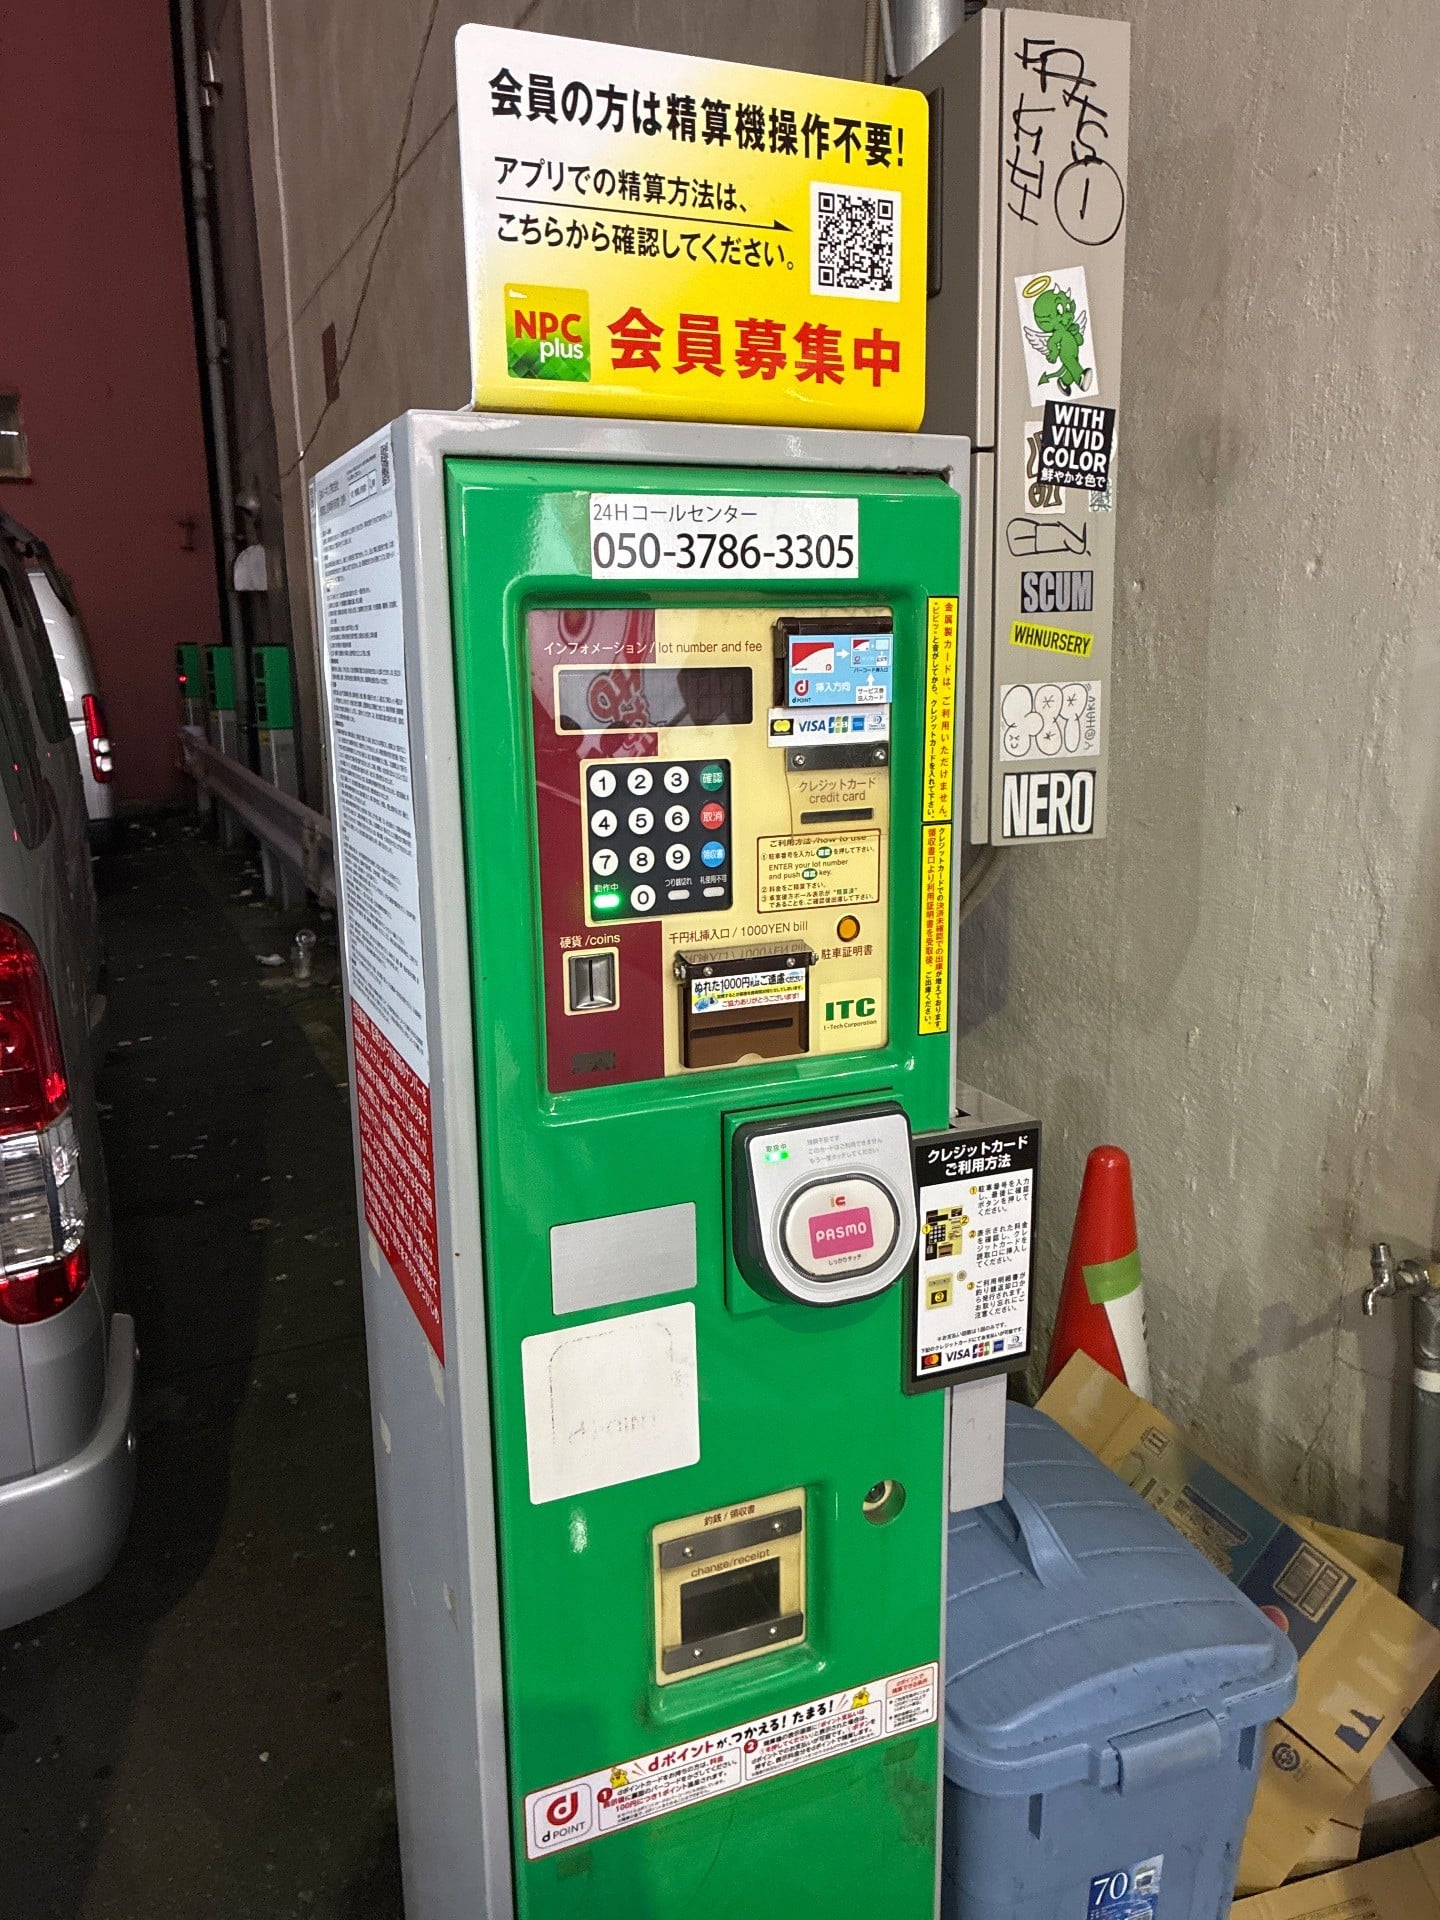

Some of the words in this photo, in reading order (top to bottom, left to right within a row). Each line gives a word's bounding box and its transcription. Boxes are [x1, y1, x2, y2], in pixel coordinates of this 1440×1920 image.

[489, 67, 904, 168] 会員の方は精算機操作不要!
[494, 156, 749, 212] アプリでの精算方法は、
[497, 212, 795, 271] こちらから確認してください。
[514, 310, 582, 342] NPC
[540, 340, 584, 364] plus
[608, 306, 901, 387] 会員募集中
[1054, 404, 1105, 430] WITH
[1051, 425, 1104, 451] VIVID
[1042, 447, 1106, 473] COLOR
[1040, 466, 1106, 488] 鮮やかな色で
[593, 533, 854, 569] 050-3786-3305
[1023, 572, 1092, 612] SCUM
[544, 641, 646, 655] インフォメーション
[659, 641, 674, 653] lot
[676, 641, 718, 653] number
[721, 640, 741, 652] and
[745, 640, 762, 652] fee
[1015, 625, 1090, 655] WHNURSERY
[815, 682, 851, 692] 挿入方向
[939, 602, 953, 818] 金属製カードは、ご利用いただけません。
[799, 720, 826, 732] VISA
[635, 775, 646, 789] 2
[671, 773, 682, 787] 3
[799, 777, 876, 793] クレジットカード
[809, 794, 839, 804] credit
[842, 791, 866, 801] card
[1003, 771, 1094, 836] NERO
[599, 816, 610, 830] 4
[635, 814, 647, 828] 5
[672, 812, 683, 826] 6
[702, 811, 723, 823] 取消
[600, 855, 611, 869] 7
[636, 853, 648, 867] 8
[672, 850, 684, 864] 9
[769, 862, 793, 871] ENTER
[795, 862, 810, 871] your
[823, 859, 849, 867] number
[784, 872, 800, 880] push
[594, 883, 619, 892] 動作中
[638, 891, 649, 904] 0
[560, 936, 583, 949] 硬貨
[669, 929, 729, 944] 千円札挿入口
[741, 923, 790, 939] 1000YEN
[793, 920, 808, 933] bill
[821, 944, 873, 960] 駐車証明書
[825, 997, 876, 1021] ITC
[844, 1020, 877, 1028] Corporation
[928, 1135, 1028, 1164] クレジットカード
[945, 1154, 1011, 1176] ご利用方法
[815, 1222, 867, 1243] PASMO
[946, 1349, 970, 1362] VISA
[704, 1512, 721, 1526] 釣銭
[730, 1504, 755, 1519] 領収書
[691, 1548, 770, 1578] change/receipt
[1094, 1872, 1128, 1905] 70
